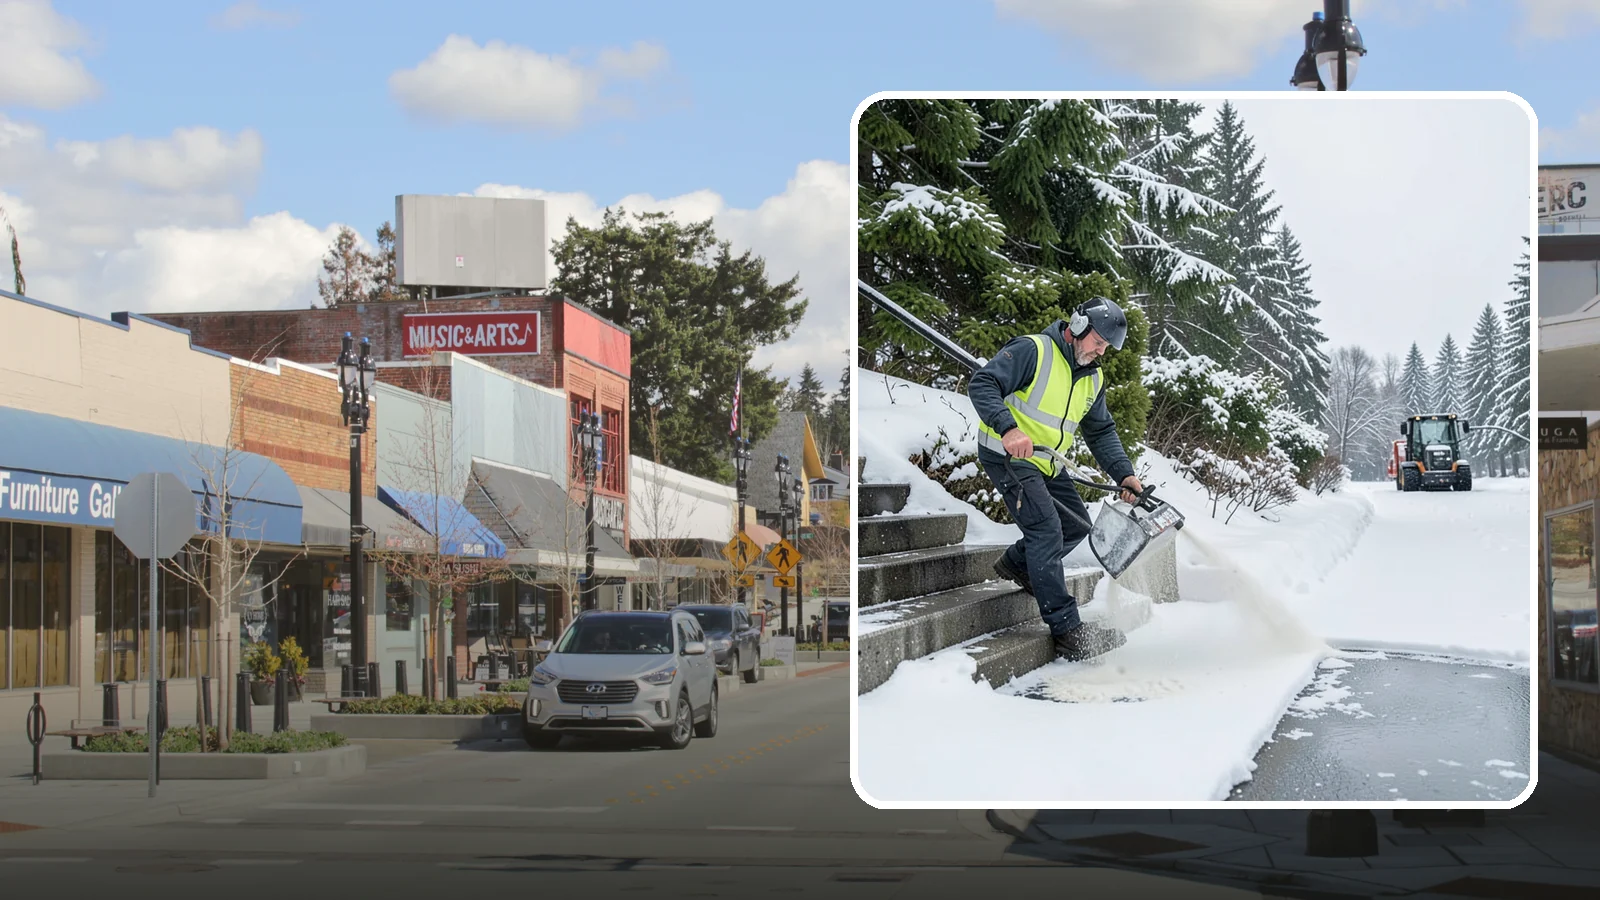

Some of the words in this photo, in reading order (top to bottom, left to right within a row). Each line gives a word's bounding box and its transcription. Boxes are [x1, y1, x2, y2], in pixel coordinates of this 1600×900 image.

[0, 471, 79, 515] Furniture
[90, 482, 122, 519] Gal
[452, 562, 479, 573] SUSHI
